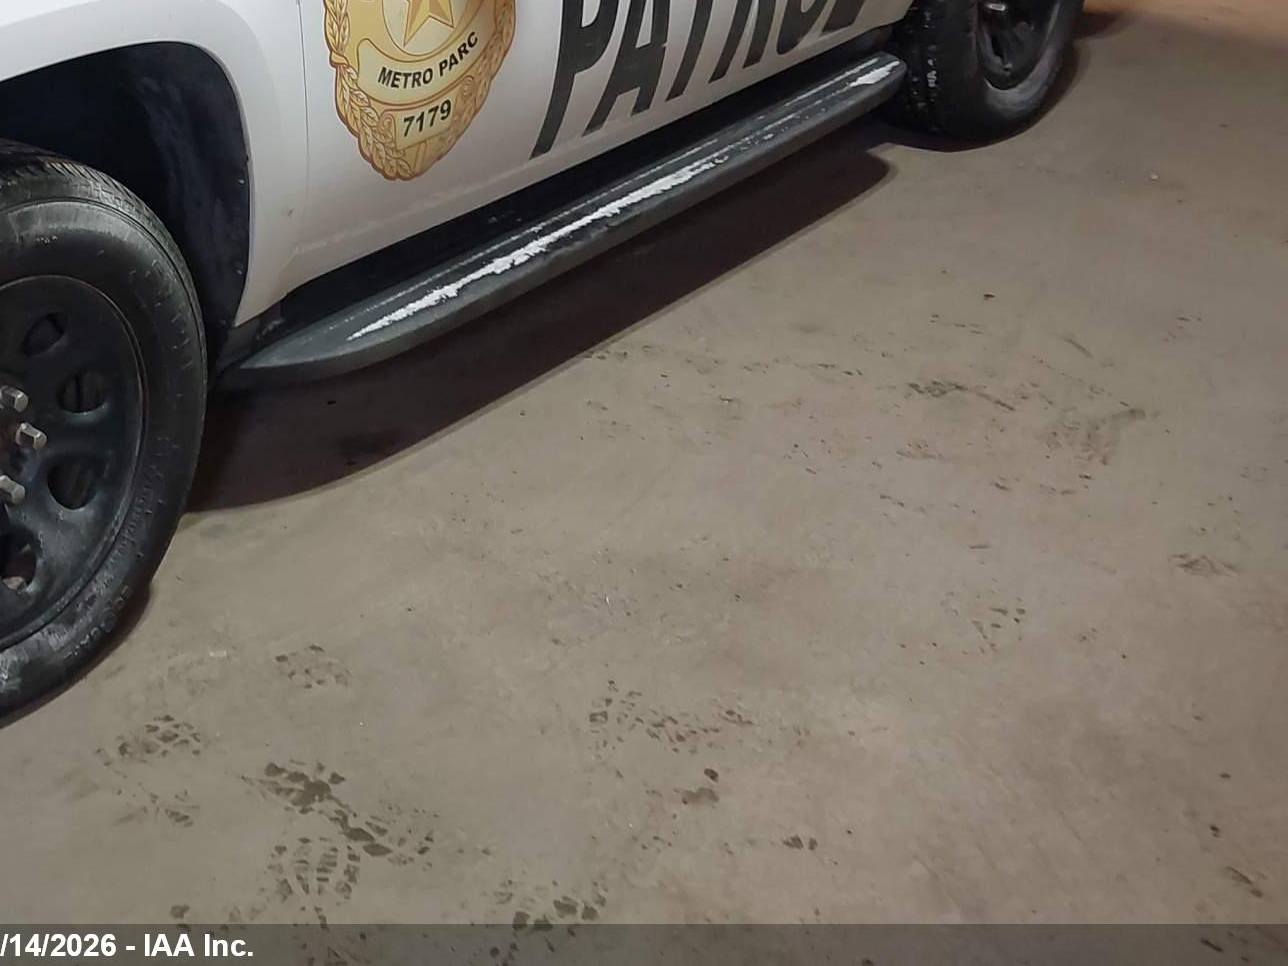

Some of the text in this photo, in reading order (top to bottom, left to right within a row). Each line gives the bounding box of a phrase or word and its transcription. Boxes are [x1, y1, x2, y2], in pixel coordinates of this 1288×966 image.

[377, 31, 479, 90] METRO PARC
[402, 99, 451, 137] 7179
